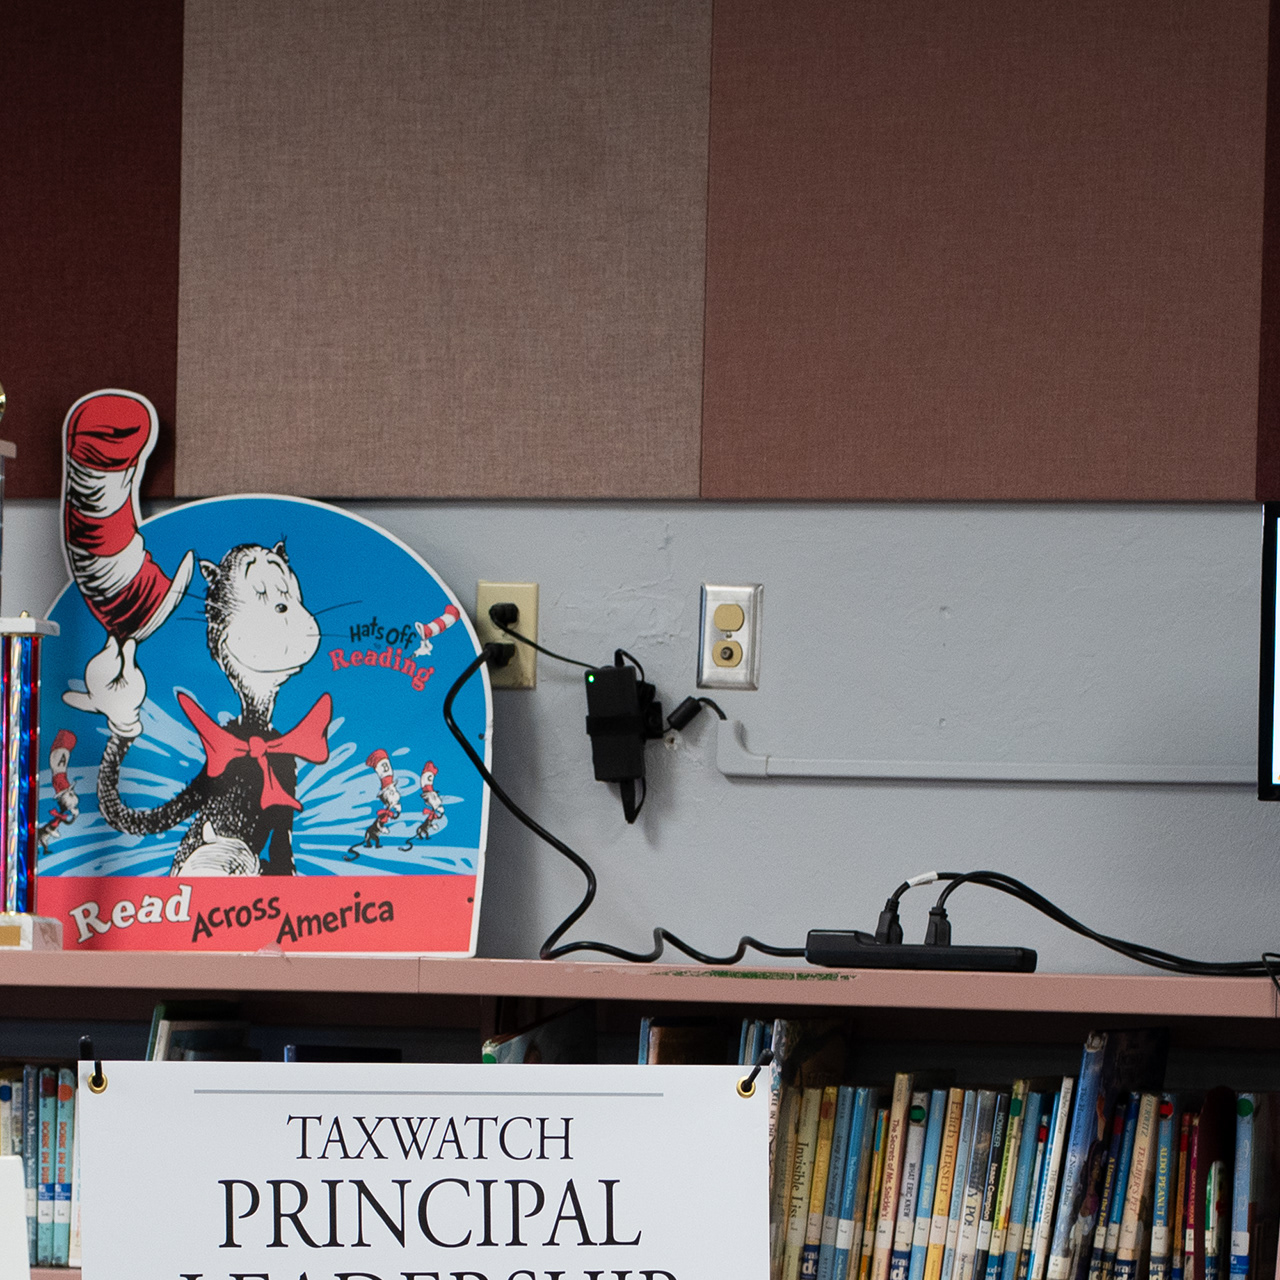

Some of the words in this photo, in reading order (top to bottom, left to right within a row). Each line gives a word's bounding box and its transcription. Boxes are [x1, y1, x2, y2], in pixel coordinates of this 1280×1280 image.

[350, 616, 384, 643] Hats
[386, 626, 416, 650] Off
[328, 647, 435, 692] Reading
[58, 754, 66, 767] A
[381, 762, 390, 773] B
[70, 884, 193, 943] Read
[276, 892, 394, 944] America
[1079, 1087, 1088, 1102] The
[891, 1119, 900, 1133] The
[947, 1101, 961, 1139] Edith
[993, 1112, 1005, 1148] HOWKER
[1071, 1103, 1085, 1148] Hunchback
[41, 1121, 49, 1148] DORK
[287, 1115, 575, 1161] TAXWATCH
[41, 1152, 49, 1164] IN
[58, 1152, 66, 1164] IN
[887, 1134, 898, 1162] Secrets
[1071, 1149, 1079, 1159] of
[1159, 1145, 1168, 1174] ALDO
[792, 1142, 809, 1191] Invisible
[887, 1163, 895, 1171] of
[907, 1162, 917, 1180] WHAT
[939, 1145, 953, 1196] HERSELF
[988, 1163, 998, 1185] Isaac
[1066, 1159, 1078, 1183] Notre
[1104, 1164, 1114, 1187] Llama
[884, 1172, 894, 1185] Ms.
[904, 1183, 916, 1197] ERIC
[983, 1185, 995, 1220] Campion
[1063, 1184, 1073, 1206] Dame
[1101, 1198, 1109, 1211] the
[1103, 1189, 1111, 1197] in
[1156, 1176, 1166, 1217] PEANUT
[217, 1178, 642, 1250] PRINCIPAL
[903, 1199, 913, 1218] KNEW
